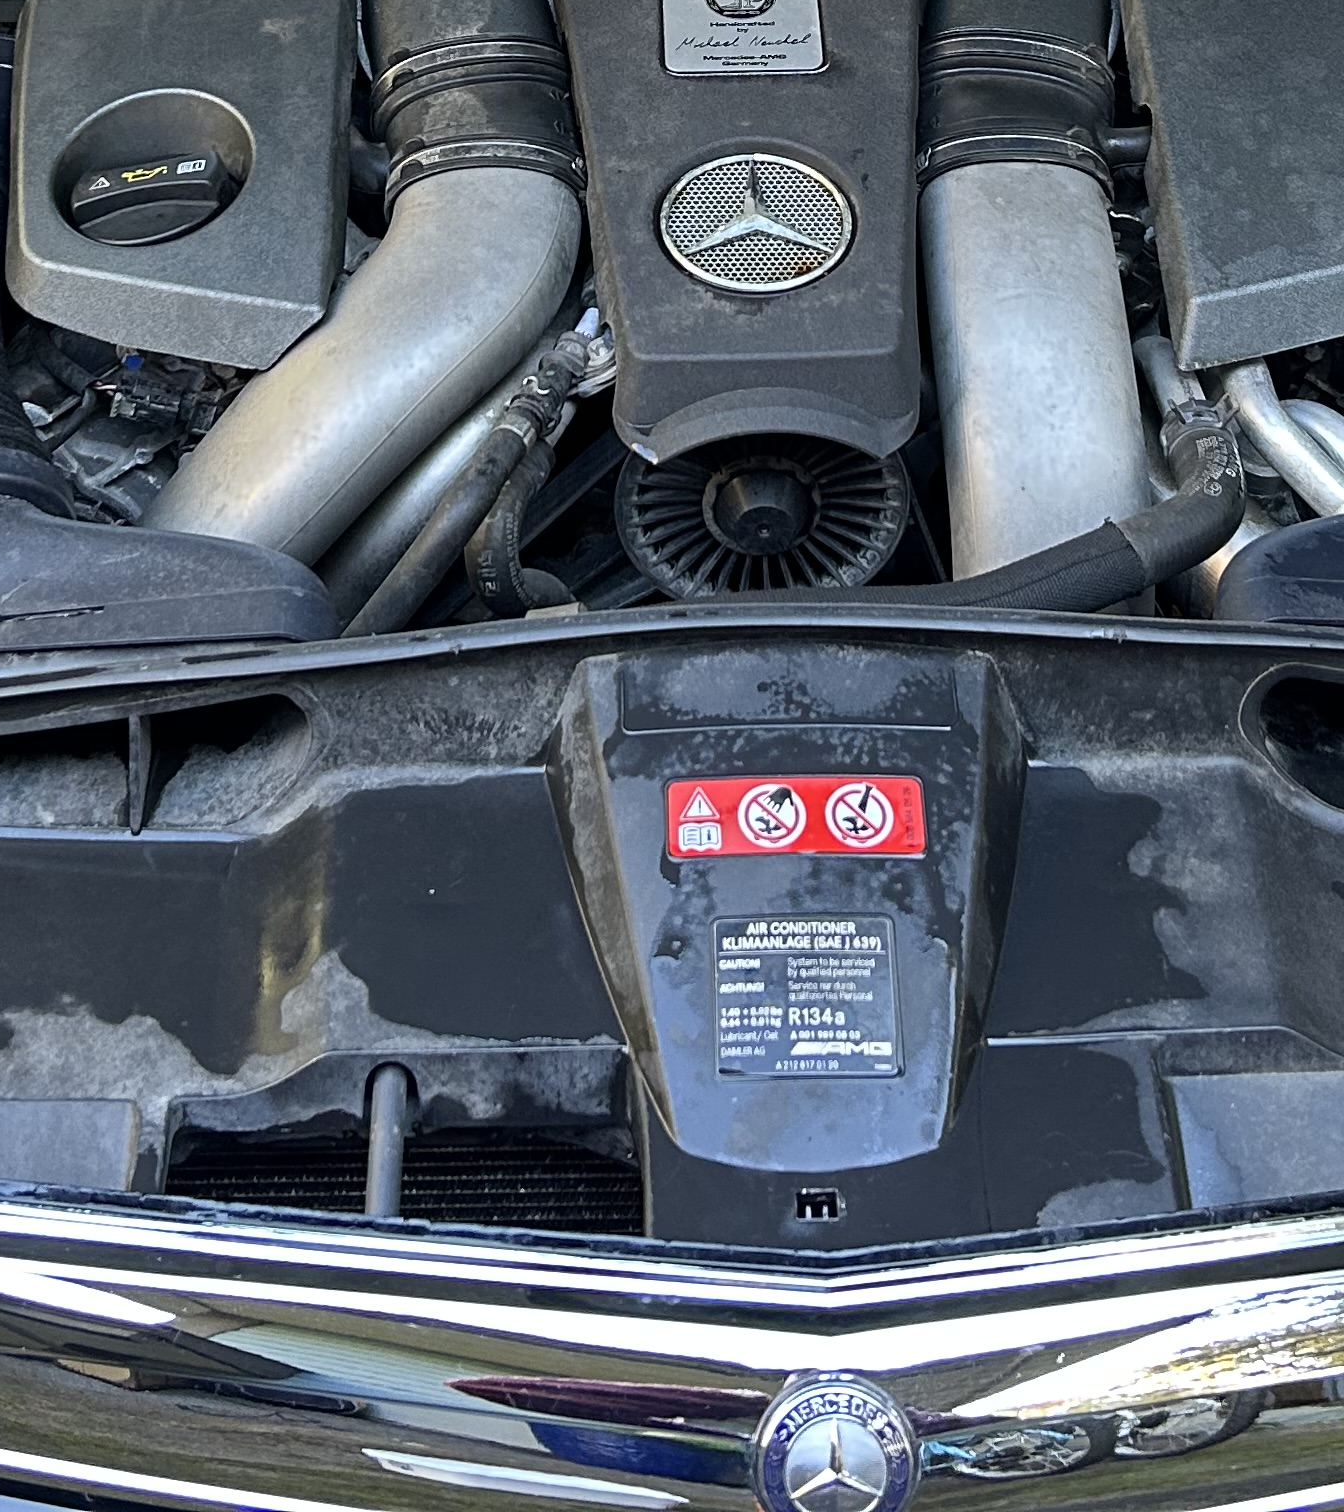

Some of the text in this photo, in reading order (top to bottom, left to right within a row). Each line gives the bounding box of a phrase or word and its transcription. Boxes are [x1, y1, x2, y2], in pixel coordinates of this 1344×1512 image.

[746, 921, 856, 935] AIR CONDITIONER
[722, 937, 811, 950] KLIMAANLAGE
[814, 937, 842, 951] (SAE
[853, 936, 882, 951] 639)
[787, 957, 875, 968] System to be serviced
[787, 967, 871, 978] by qualified personnel
[788, 981, 818, 990] Service
[833, 981, 856, 990] durch
[839, 990, 873, 1001] Personal
[788, 1007, 845, 1026] R134a
